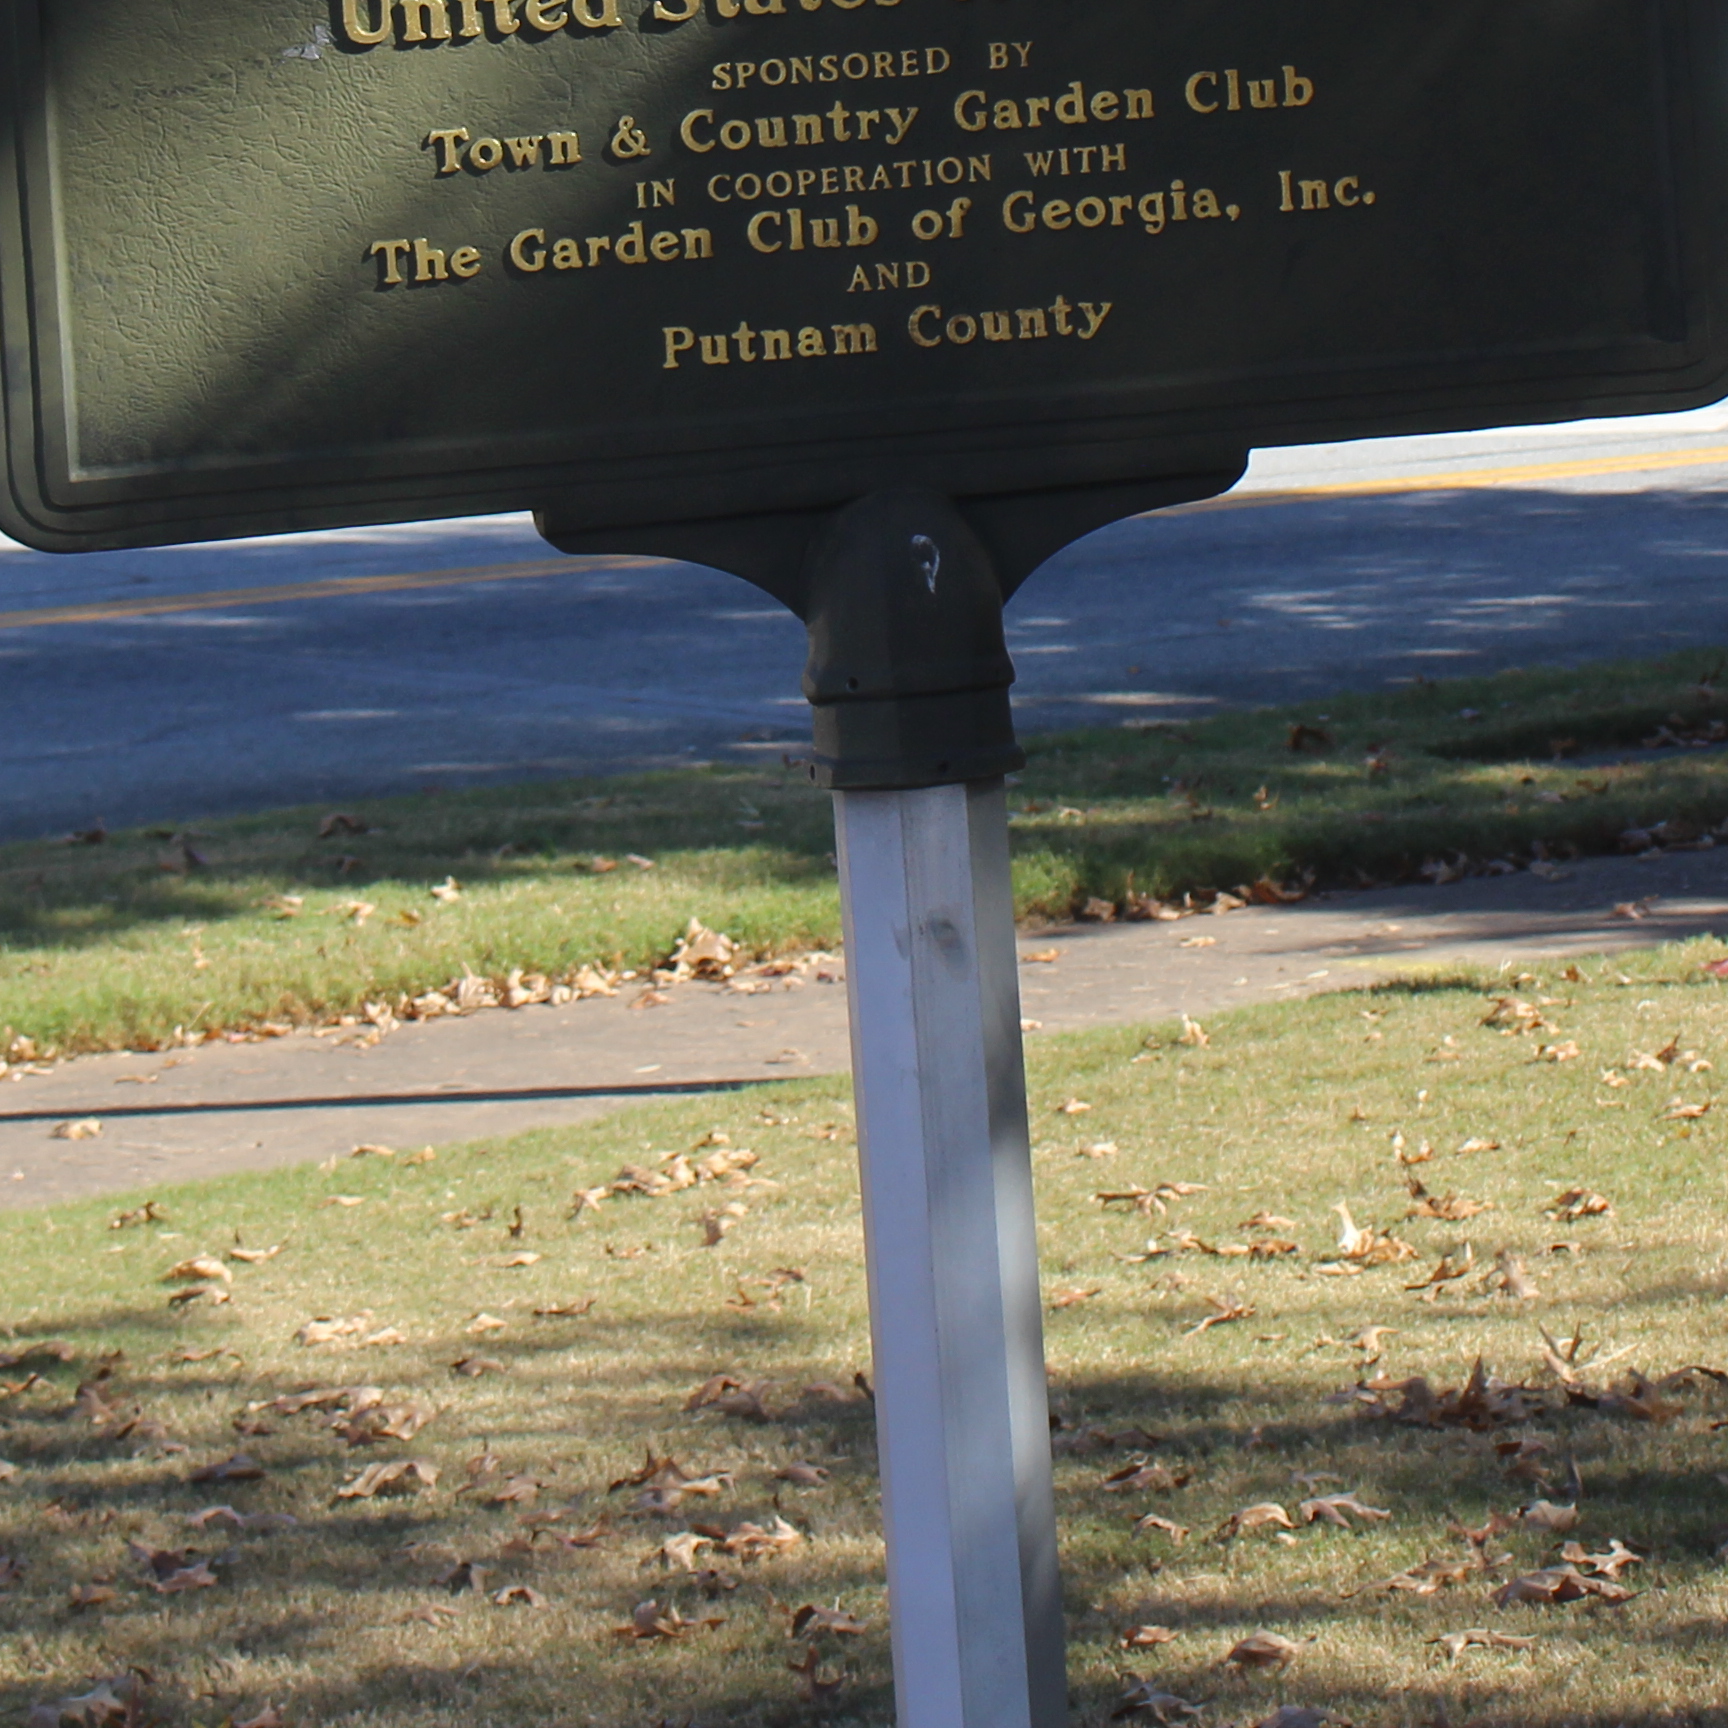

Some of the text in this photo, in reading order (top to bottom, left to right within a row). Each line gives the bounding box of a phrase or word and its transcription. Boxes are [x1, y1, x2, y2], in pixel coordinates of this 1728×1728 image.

[712, 41, 1033, 91] SPONSORED BY
[428, 65, 1314, 173] Town & Country Garden Club
[636, 143, 1127, 209] IN COOPERATION WITH
[370, 170, 1376, 284] The Garden Club of Georgia, Inc.
[846, 261, 931, 293] AND
[662, 294, 1112, 370] Putnam County
